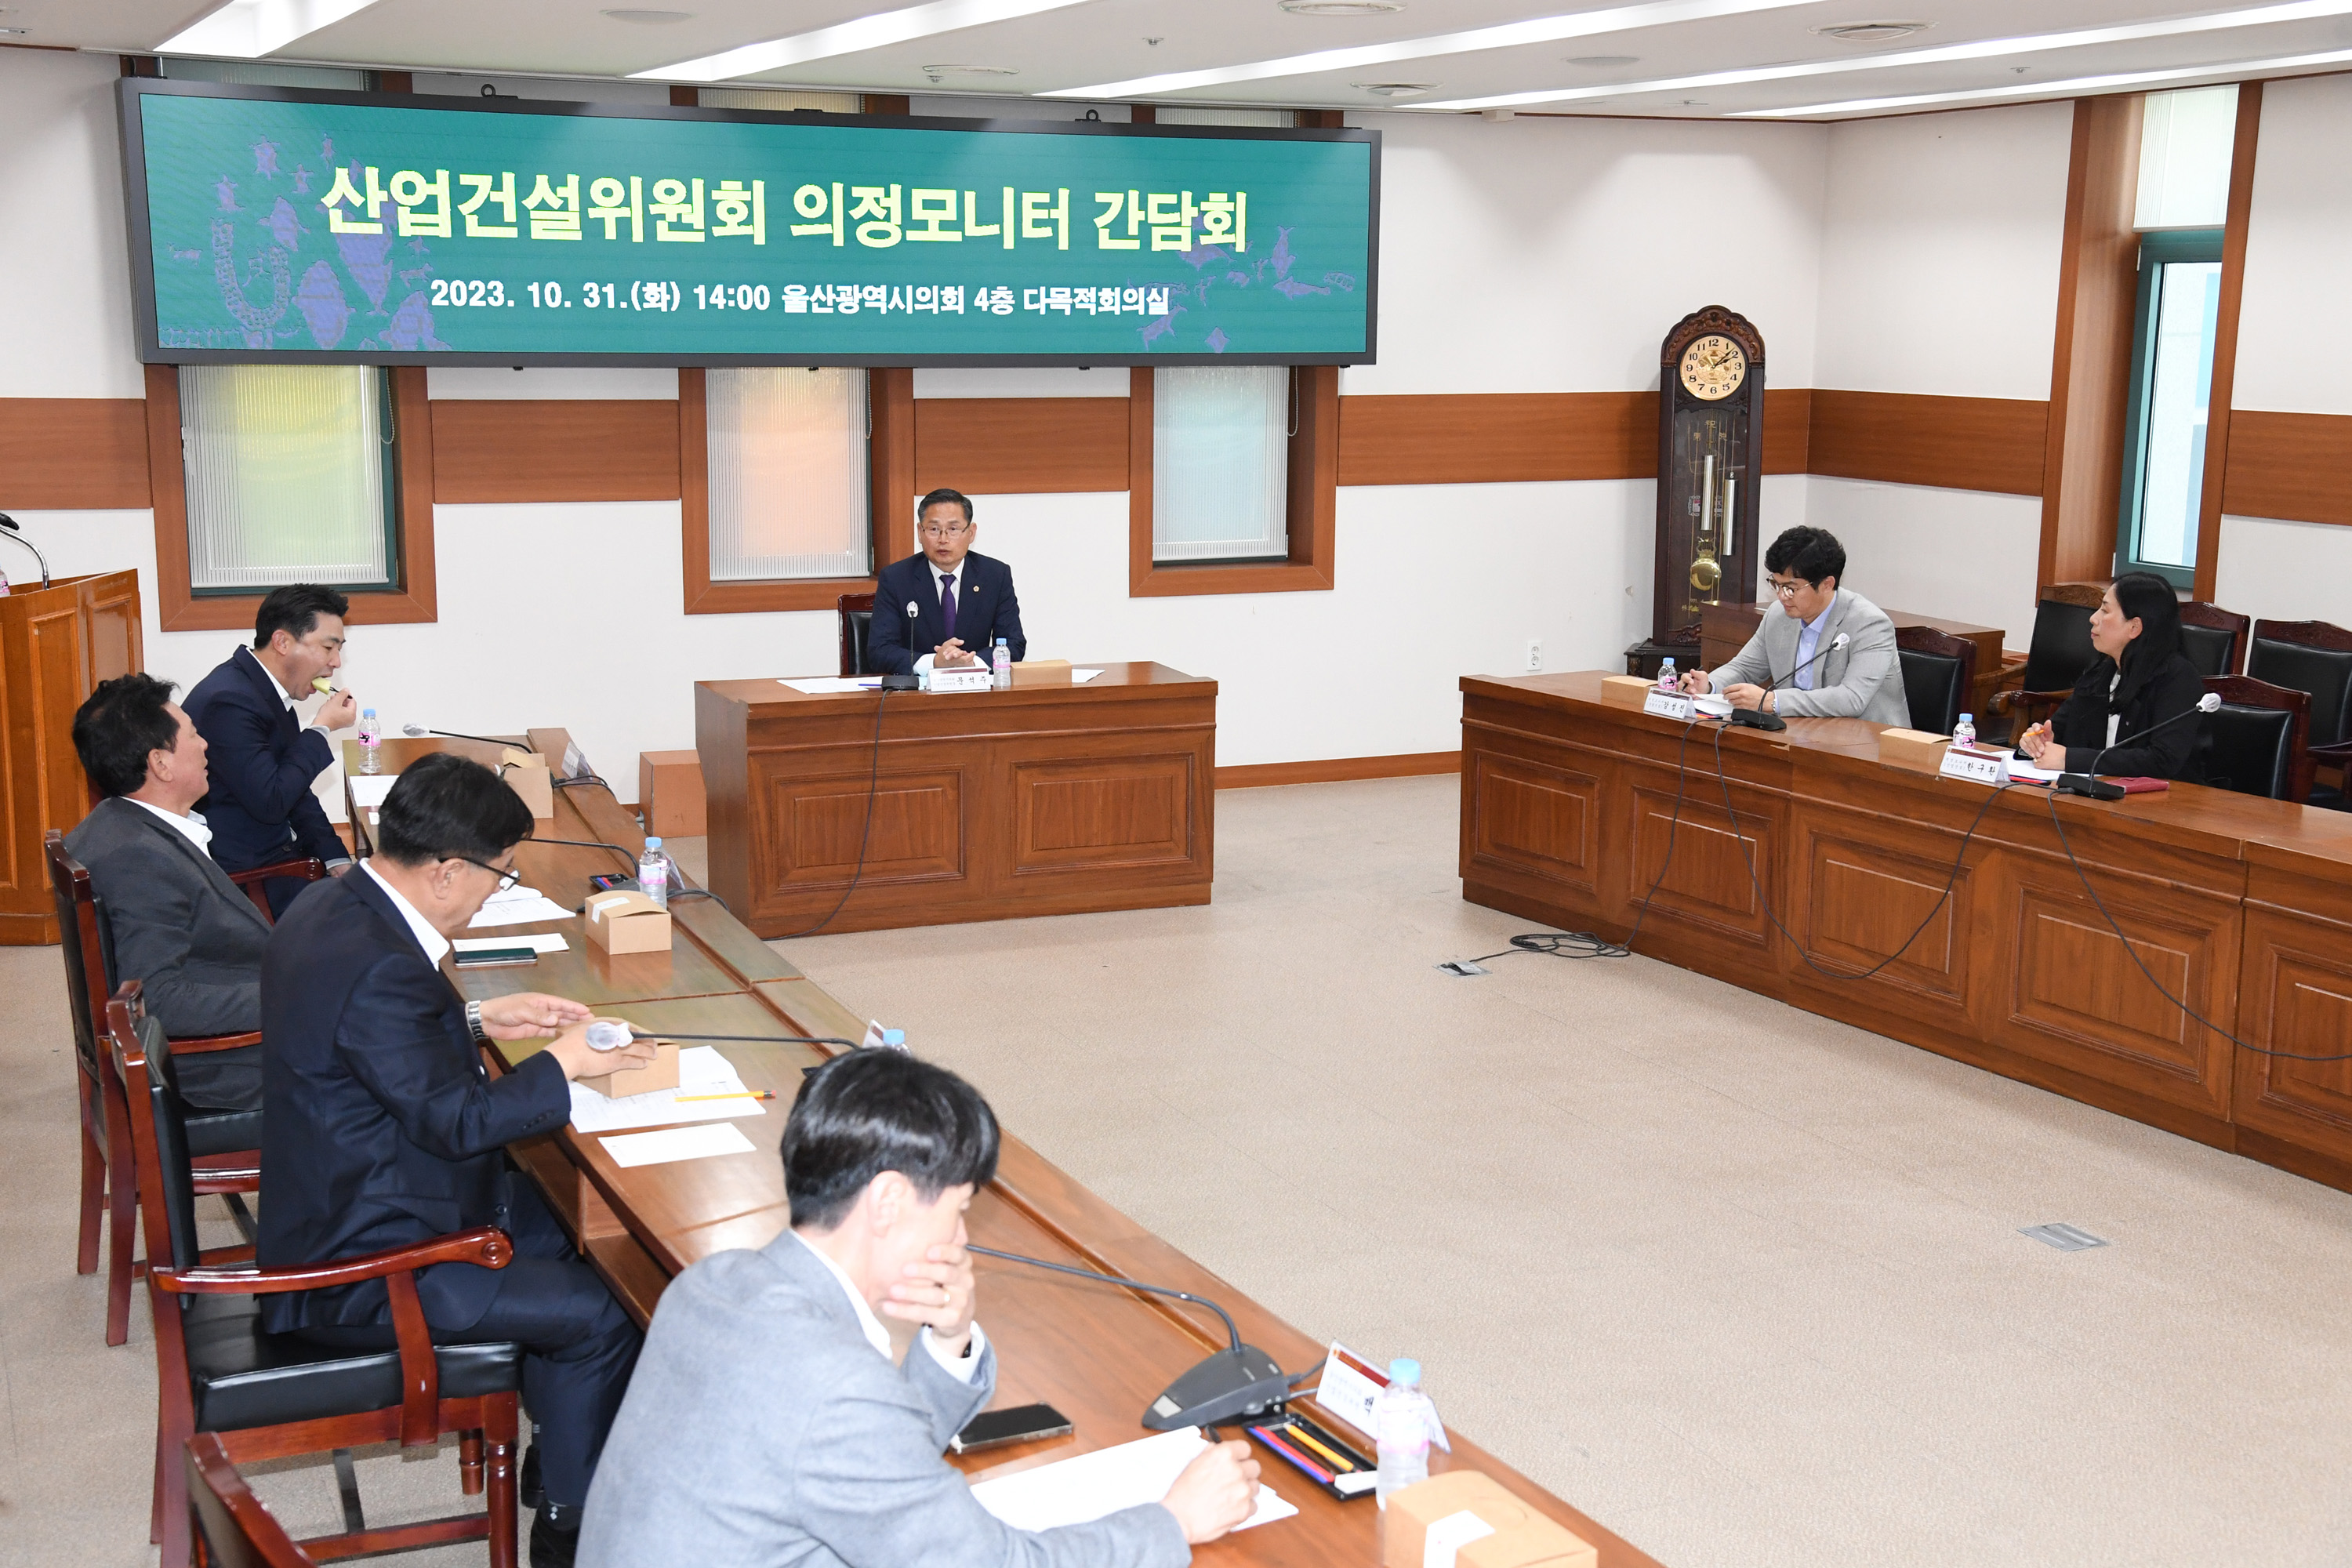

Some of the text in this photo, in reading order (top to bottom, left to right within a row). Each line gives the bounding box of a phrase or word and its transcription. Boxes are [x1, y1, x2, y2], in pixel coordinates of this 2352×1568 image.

[320, 165, 1247, 252] 산업건설위원회 의정모니터 간담회
[430, 279, 1169, 316] 2023. 10. 31.(화) 14:00 울산광역시의회 4층 다목적회의실
